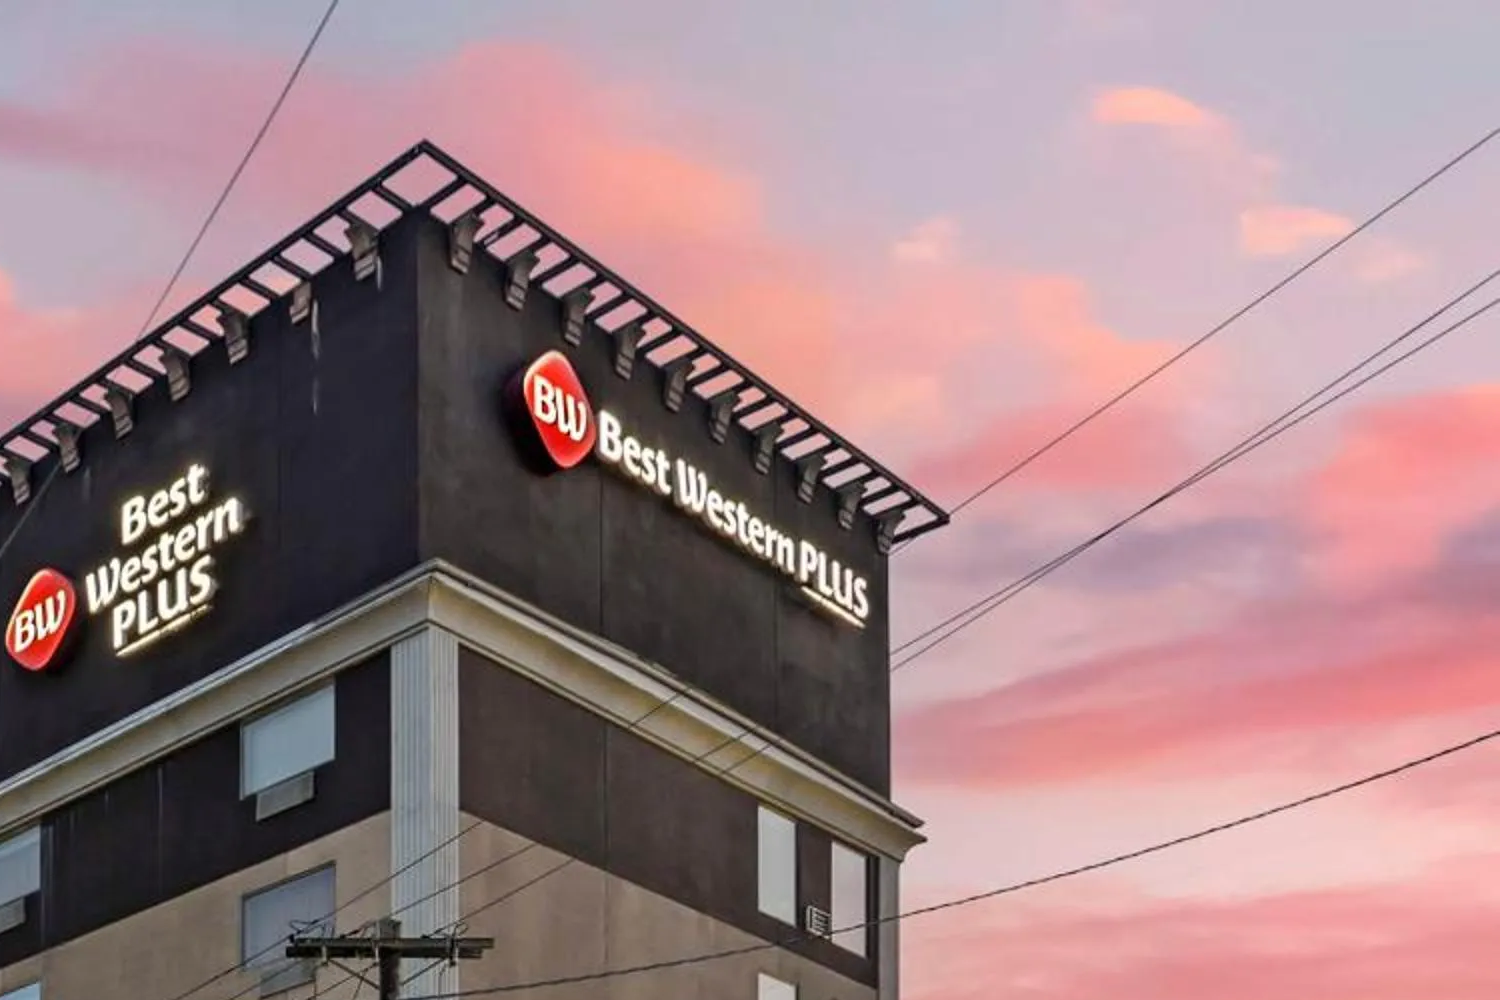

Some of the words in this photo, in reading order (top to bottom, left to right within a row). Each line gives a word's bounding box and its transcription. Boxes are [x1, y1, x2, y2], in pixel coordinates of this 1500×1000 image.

[532, 374, 587, 443] BW
[121, 462, 207, 545] Best
[599, 409, 671, 495] Best
[674, 457, 795, 573] Western
[800, 540, 869, 620] PLUS
[85, 496, 245, 615] Western
[13, 590, 65, 653] BW
[112, 553, 216, 650] PLUS
